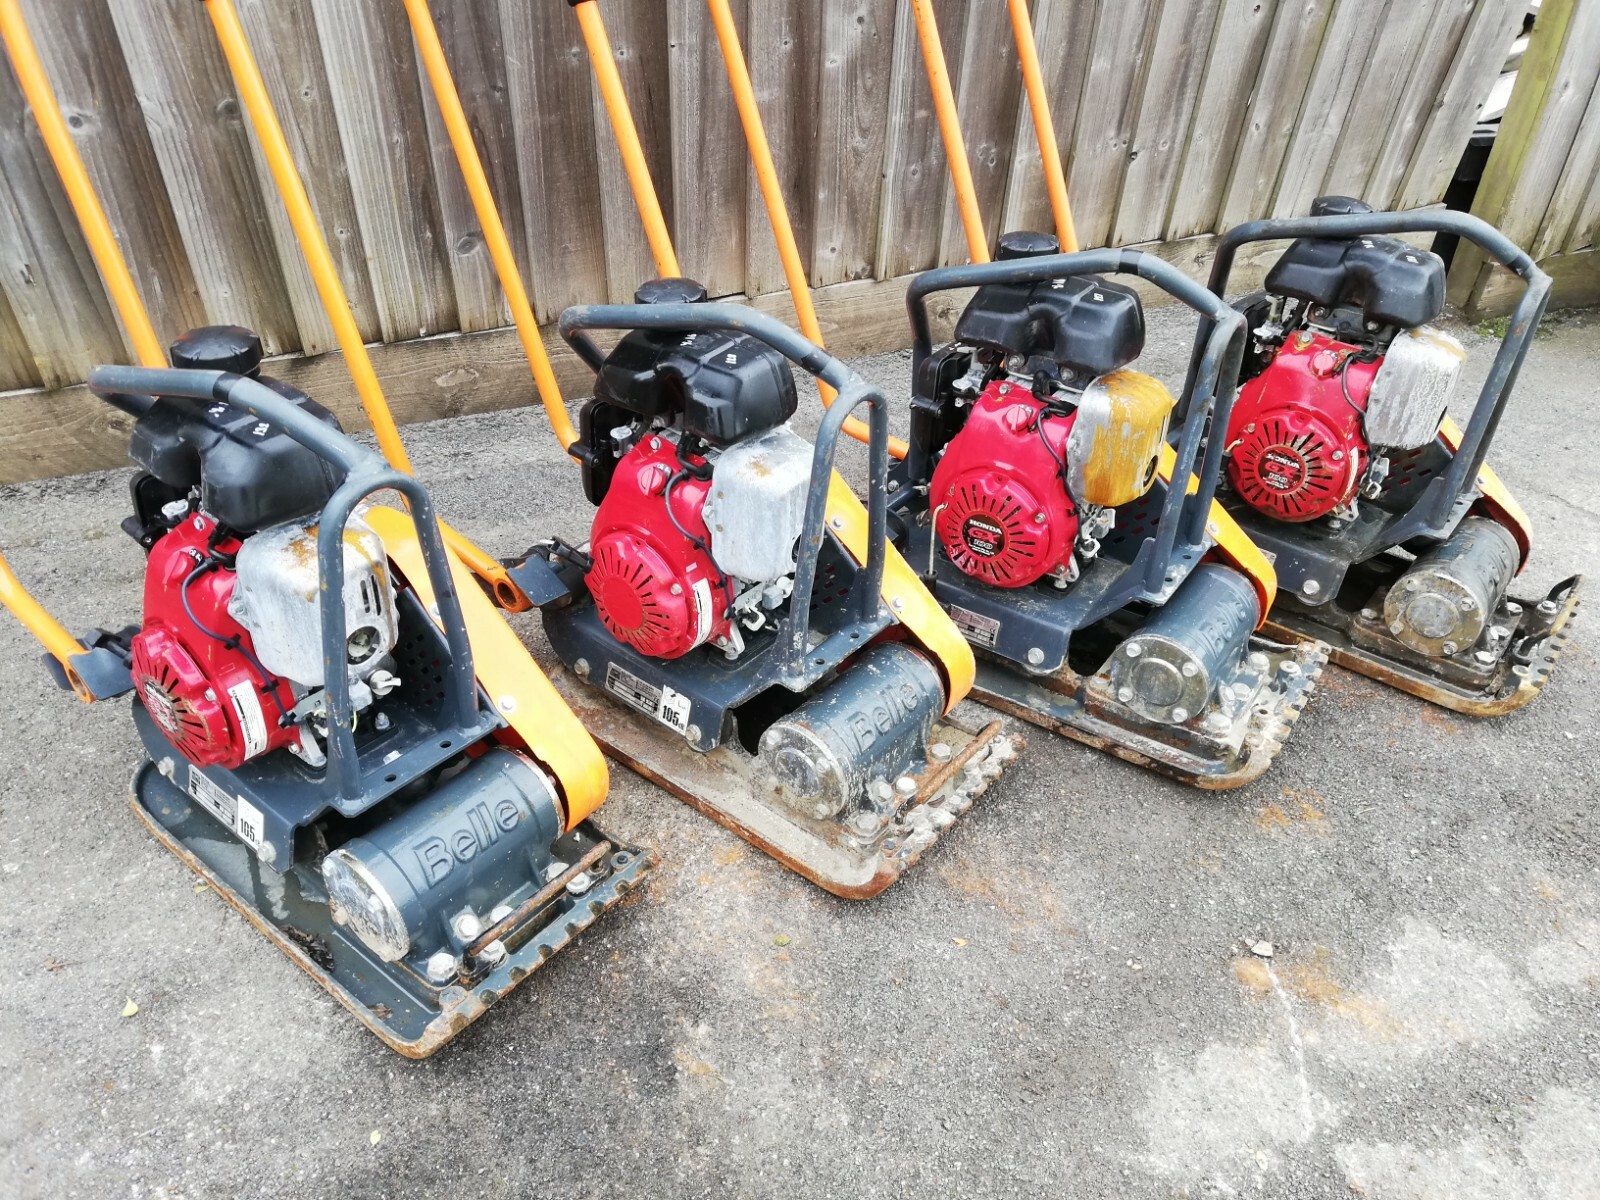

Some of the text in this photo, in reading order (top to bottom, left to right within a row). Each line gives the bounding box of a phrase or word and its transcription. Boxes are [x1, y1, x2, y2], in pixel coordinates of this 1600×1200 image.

[968, 527, 1000, 545] GX
[969, 519, 1002, 535] HONDA
[662, 705, 680, 727] 105
[846, 683, 919, 756] Belle
[240, 818, 255, 842] 105
[411, 799, 520, 889] Belle
